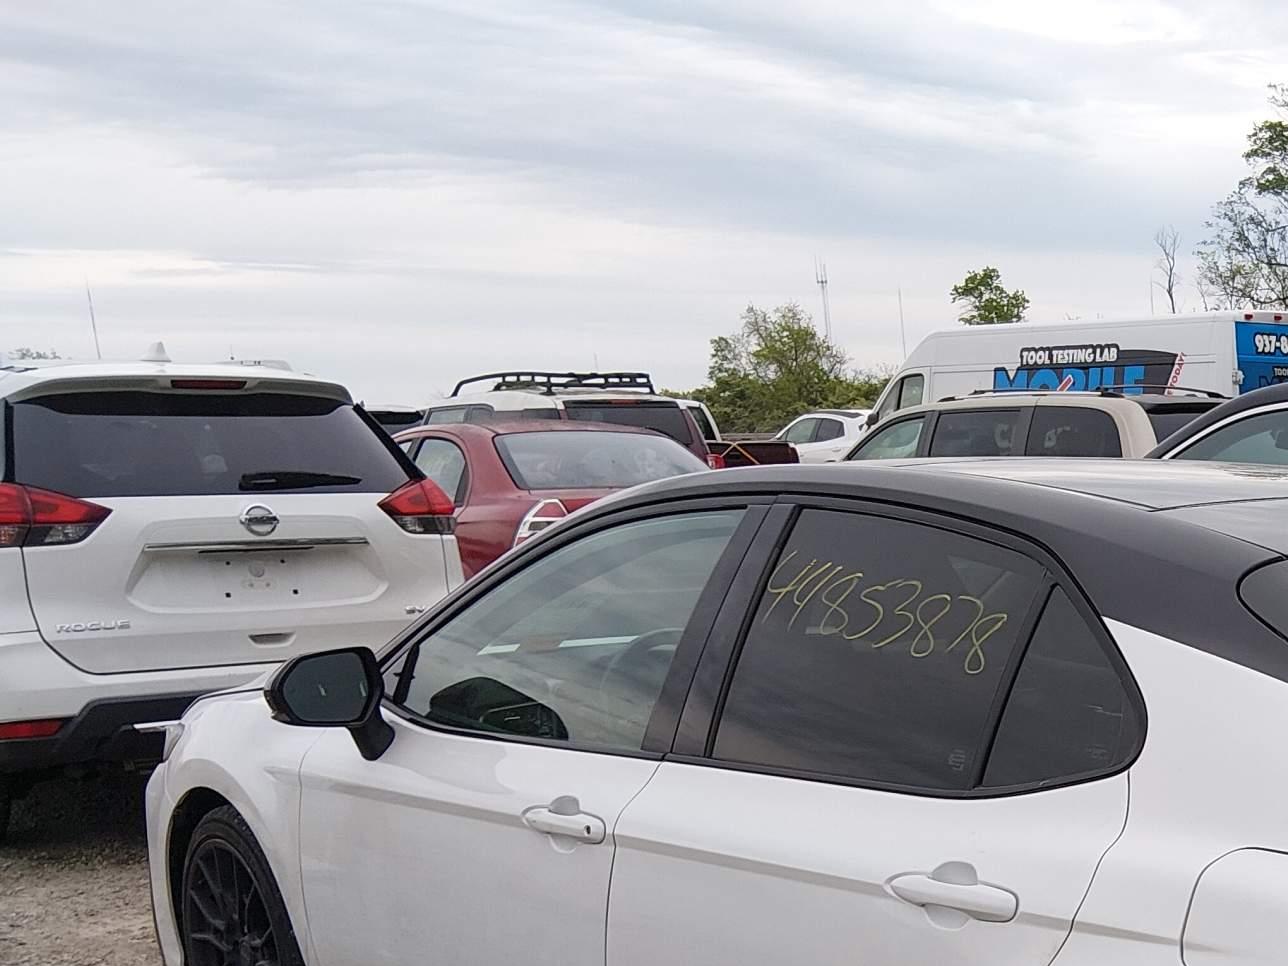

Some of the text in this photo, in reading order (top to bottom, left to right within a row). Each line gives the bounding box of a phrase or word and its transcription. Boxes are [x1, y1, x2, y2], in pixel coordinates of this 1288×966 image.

[1021, 347, 1118, 365] TOOL TESTING LAB
[761, 550, 1007, 674] 44853878
[56, 619, 131, 633] ROGUE
